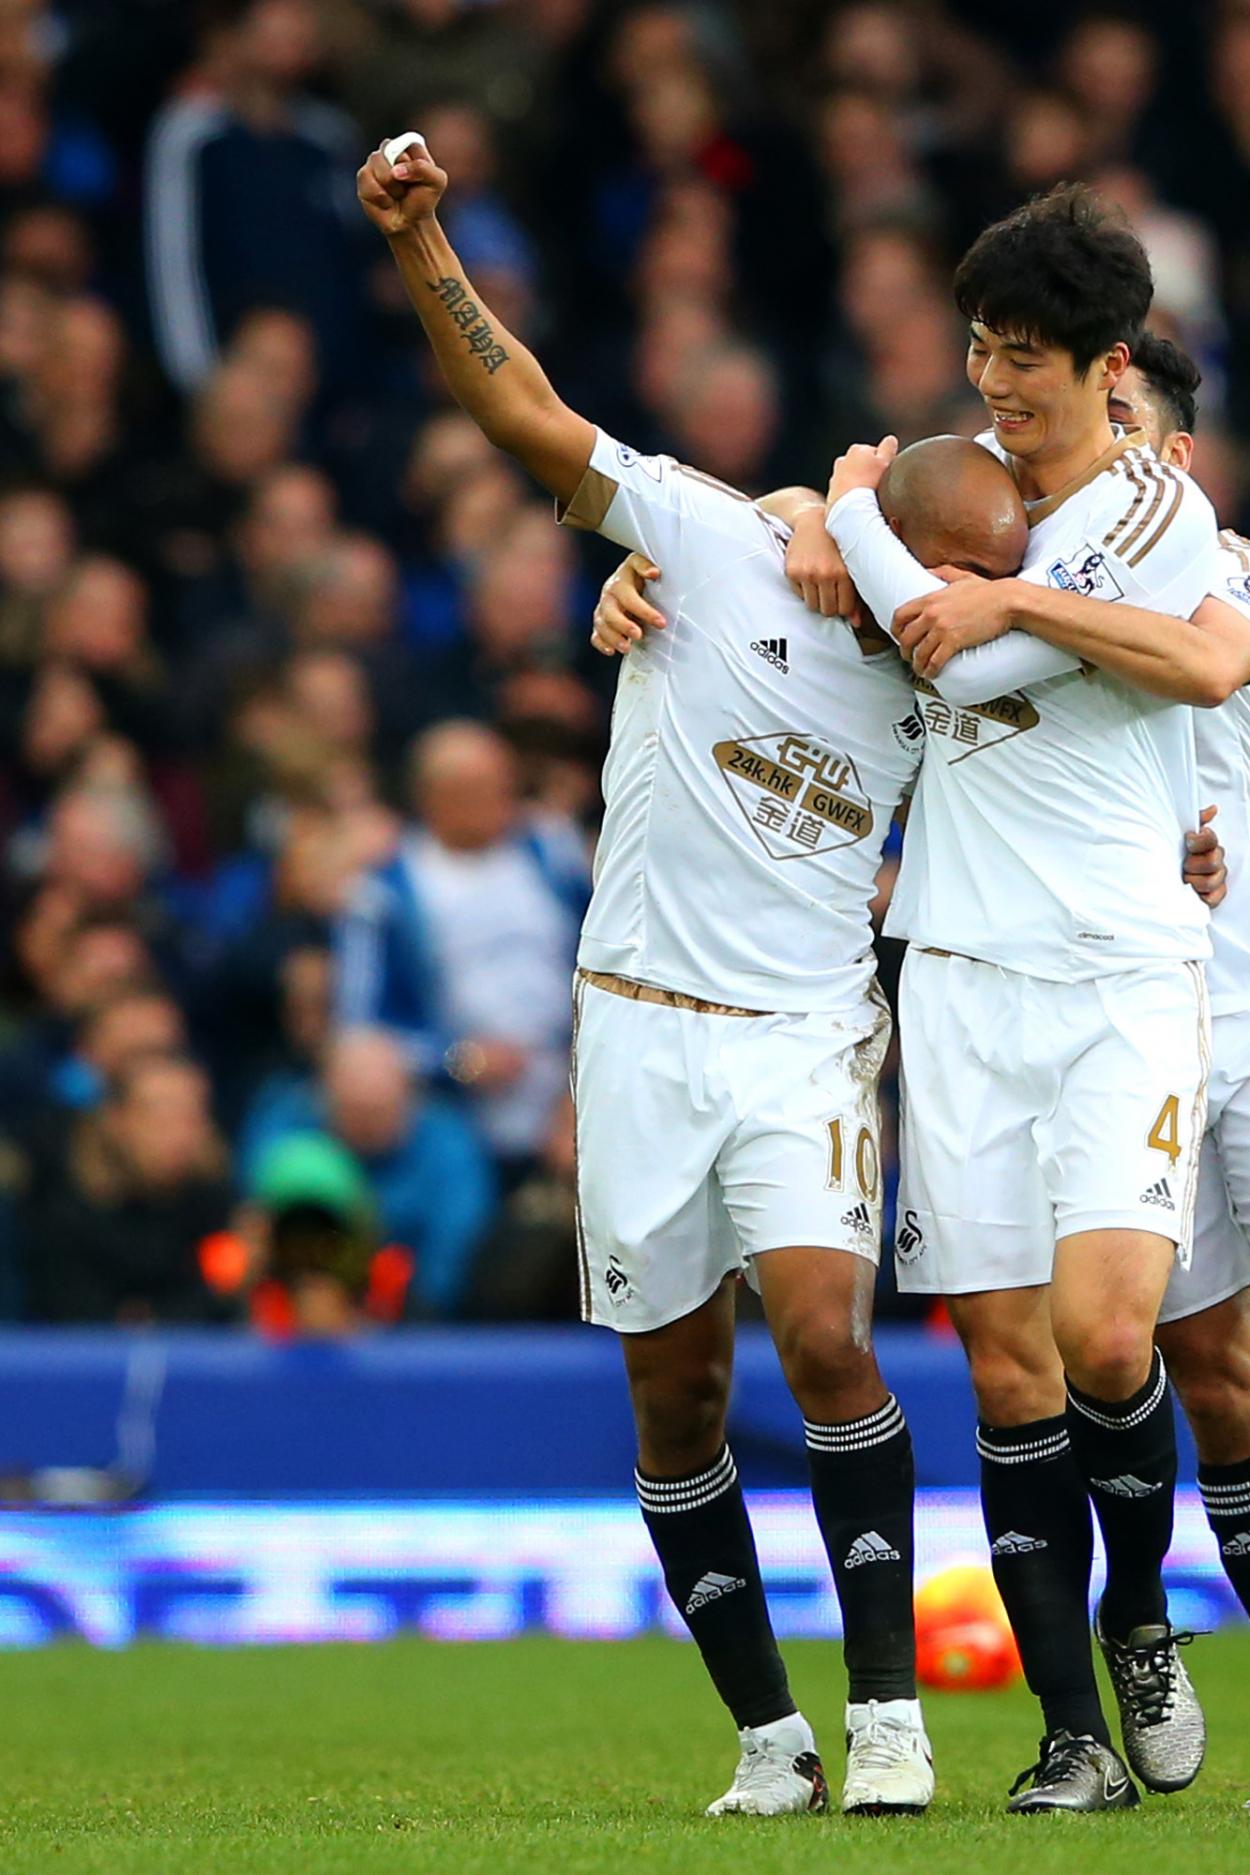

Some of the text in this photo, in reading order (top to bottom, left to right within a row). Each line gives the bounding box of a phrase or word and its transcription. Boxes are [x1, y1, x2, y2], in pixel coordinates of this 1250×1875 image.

[750, 641, 789, 674] adidas
[925, 700, 981, 746] 金道
[728, 750, 866, 832] 24k.hk GWFX
[753, 796, 825, 850] 金道
[1147, 1094, 1182, 1170] 4
[827, 1118, 879, 1203] 10
[844, 1549, 900, 1569] adidas
[685, 1577, 747, 1615] adidas
